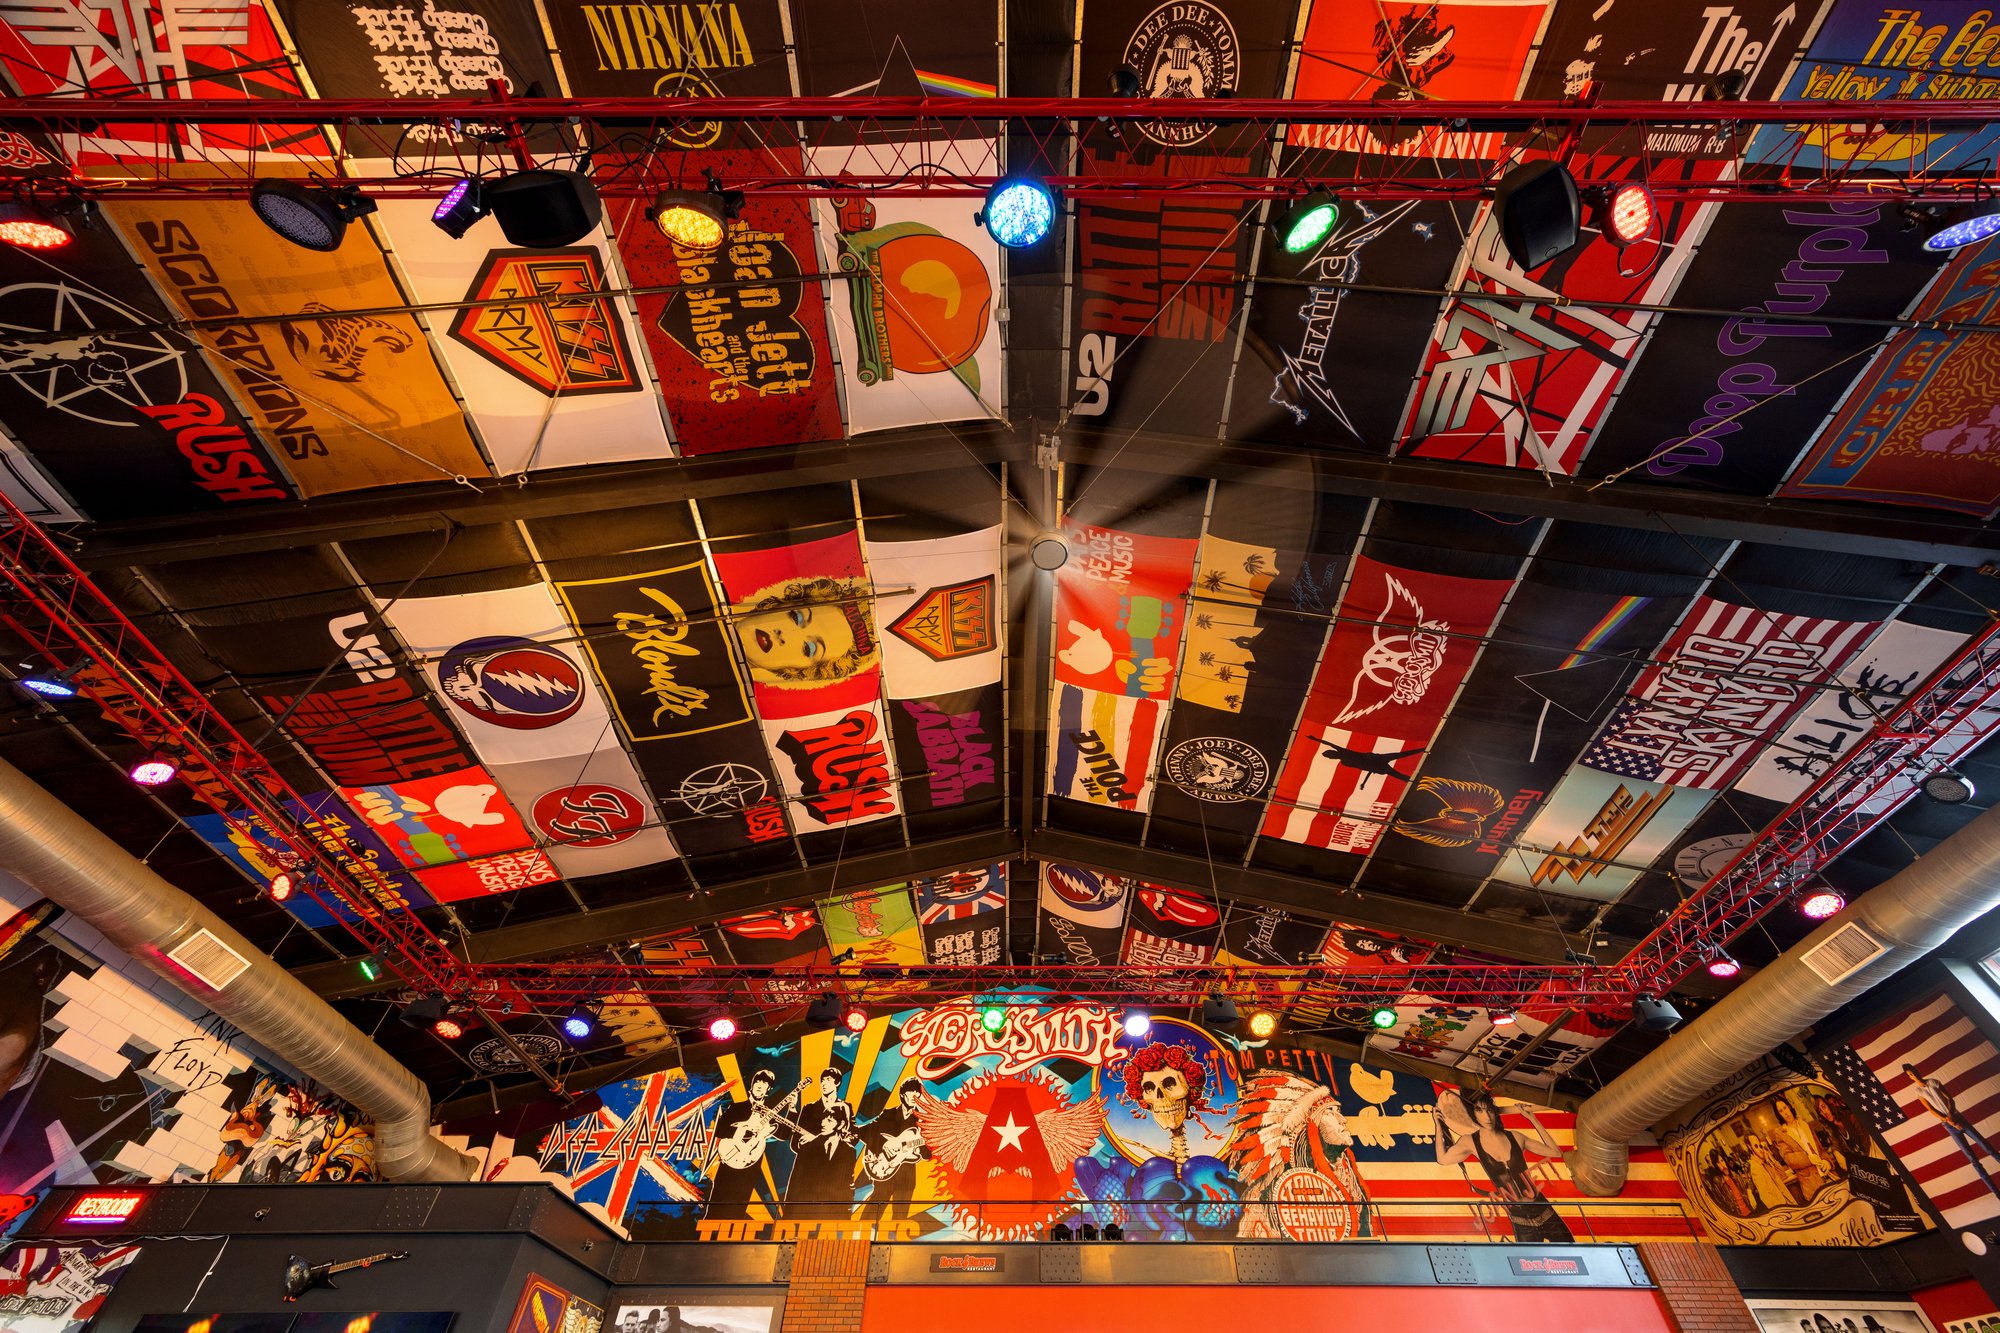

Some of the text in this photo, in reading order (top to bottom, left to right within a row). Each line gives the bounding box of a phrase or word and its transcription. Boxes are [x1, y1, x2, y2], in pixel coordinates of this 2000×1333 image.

[581, 3, 757, 71] NIRVANA
[1134, 4, 1210, 52] DEE DEE
[1212, 21, 1236, 90] TOMM
[1683, 6, 1763, 76] The
[1861, 9, 1949, 67] The
[449, 73, 514, 95] Ceap
[1800, 64, 1891, 100] Yellow
[1643, 132, 1702, 153] MAXIMUM
[1079, 146, 1166, 338] RATTLE
[531, 266, 614, 380] KISS
[728, 220, 812, 398] Joan Jett
[874, 308, 892, 364] BROTHERS
[135, 219, 329, 461] SCORPIONS
[727, 334, 749, 376] and the
[1072, 332, 1117, 418] U2
[134, 391, 288, 503] RUSH
[951, 587, 986, 647] KISS
[328, 611, 397, 684] U2
[1391, 624, 1446, 702] AEROSMIT
[784, 708, 897, 826] RUSH
[902, 699, 965, 808] SABBATH
[949, 709, 996, 789] BLACK
[1068, 729, 1137, 804] POLICE
[1195, 739, 1238, 751] JOEY
[1240, 747, 1264, 771] DEE
[1078, 775, 1102, 798] THE
[1330, 820, 1358, 847] BRUCE
[1352, 800, 1395, 850] SPRINGTEEN
[152, 1037, 223, 1097] FLOYD
[1210, 1049, 1341, 1097] TOM PETTY
[539, 1111, 600, 1182] DEF
[74, 1197, 140, 1217] RESTROOMS
[1280, 1208, 1344, 1227] BEHAVIOR
[1294, 1228, 1338, 1242] TOUR
